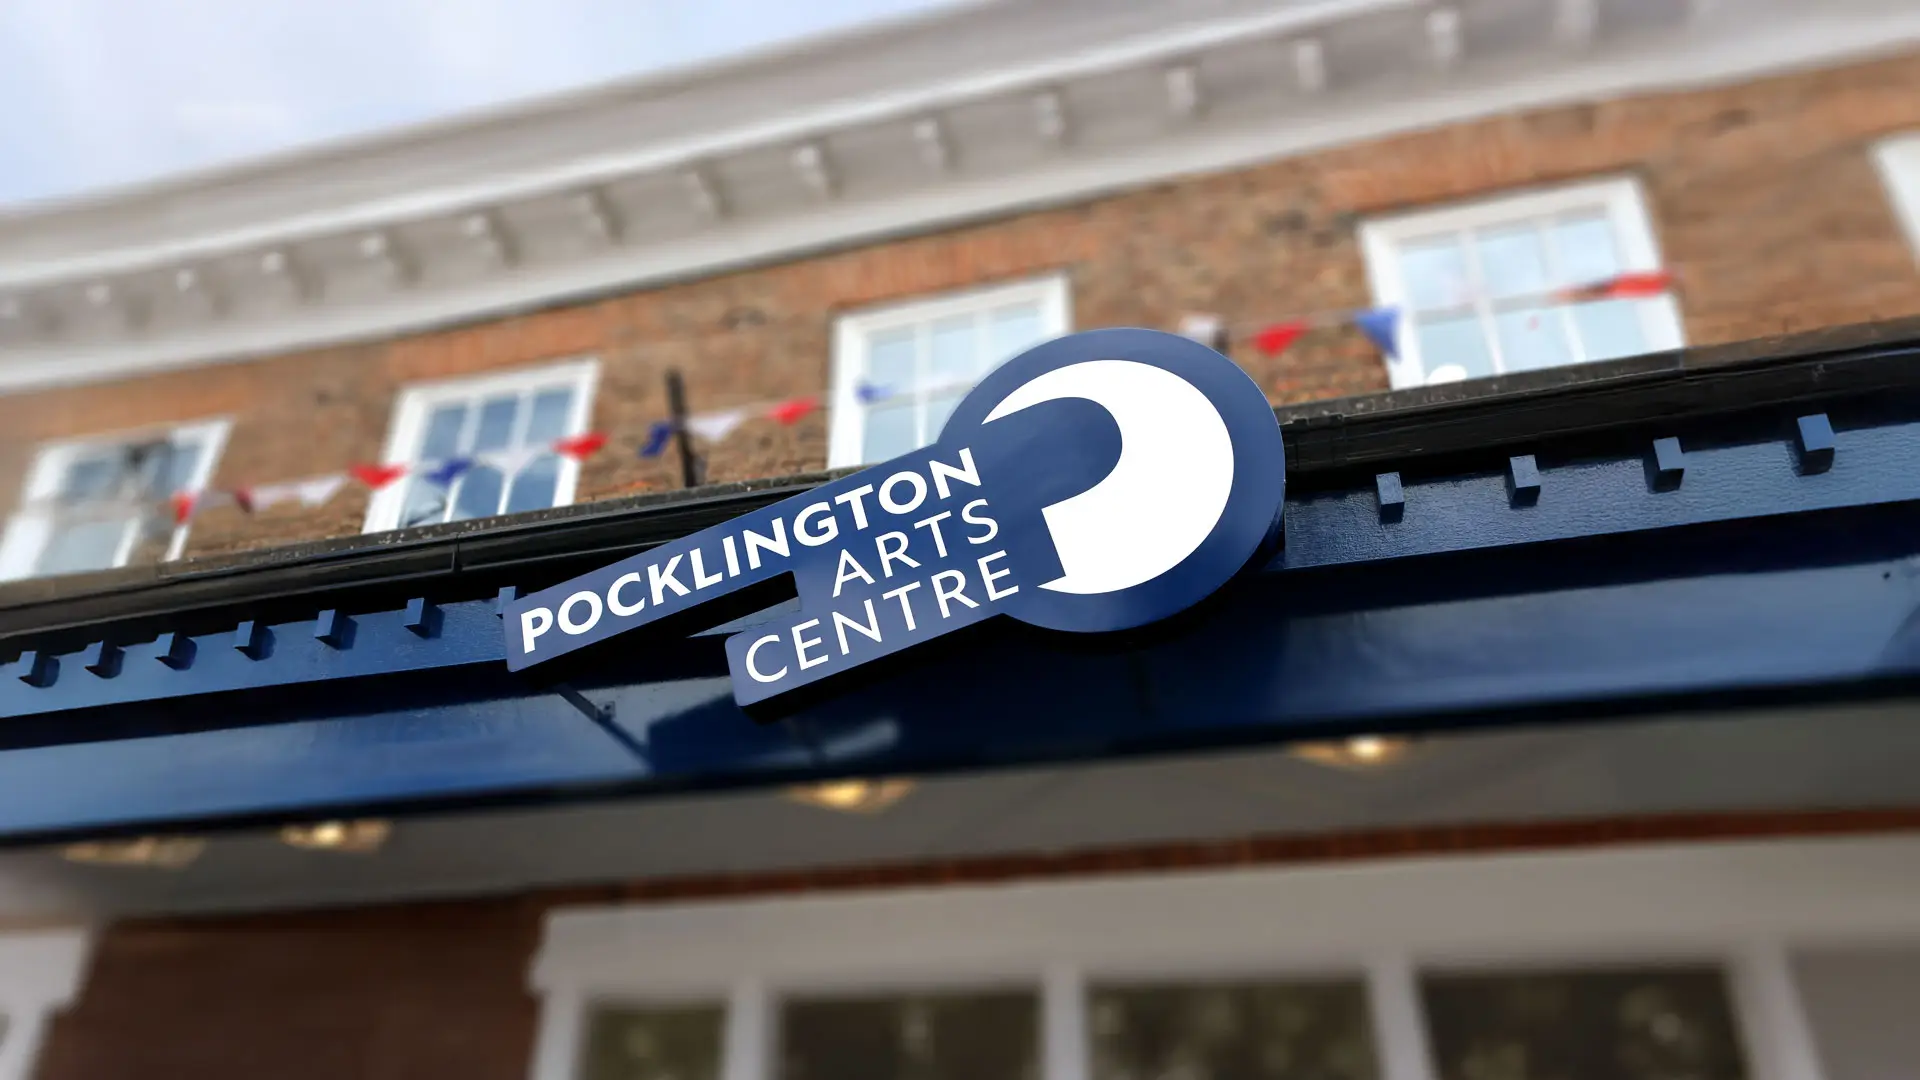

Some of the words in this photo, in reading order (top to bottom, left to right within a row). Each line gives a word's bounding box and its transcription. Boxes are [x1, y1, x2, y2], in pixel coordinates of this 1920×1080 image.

[521, 447, 982, 654] POCKLINGTON
[832, 498, 999, 598] ARTS
[745, 549, 1020, 683] CENTRE
